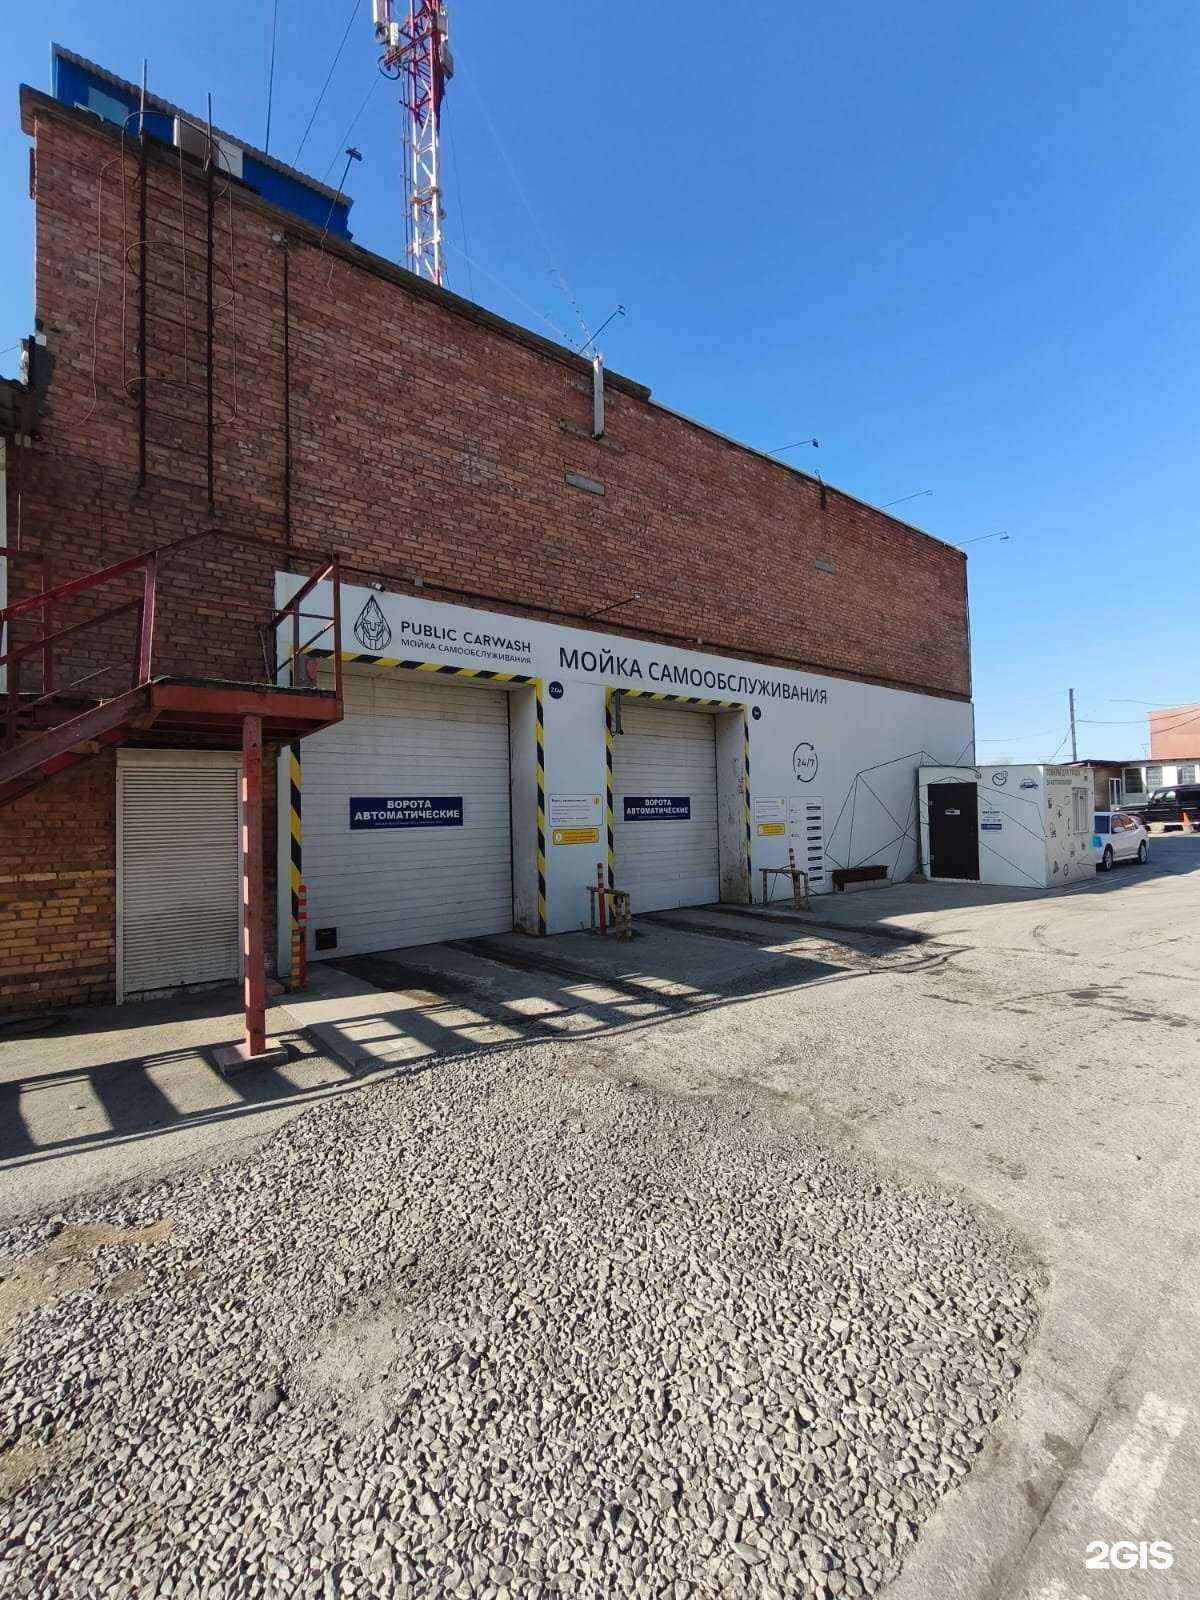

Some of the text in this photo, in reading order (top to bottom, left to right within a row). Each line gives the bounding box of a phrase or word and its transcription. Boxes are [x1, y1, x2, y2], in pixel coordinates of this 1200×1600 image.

[401, 621, 531, 653] PUBLIC CARWASH
[401, 638, 532, 664] МОЙКА САМООБСЛУЖИВАНИЯ
[559, 647, 828, 705] МОЙКА САМООБСЛУЖИВАНИЯ
[797, 758, 815, 768] 24/7
[386, 799, 432, 809] ВОРОТА
[354, 809, 460, 821] АВТОМАТИЧЕСКИЕ
[626, 806, 689, 815] АВТОМАТИЧЕСКИЕ
